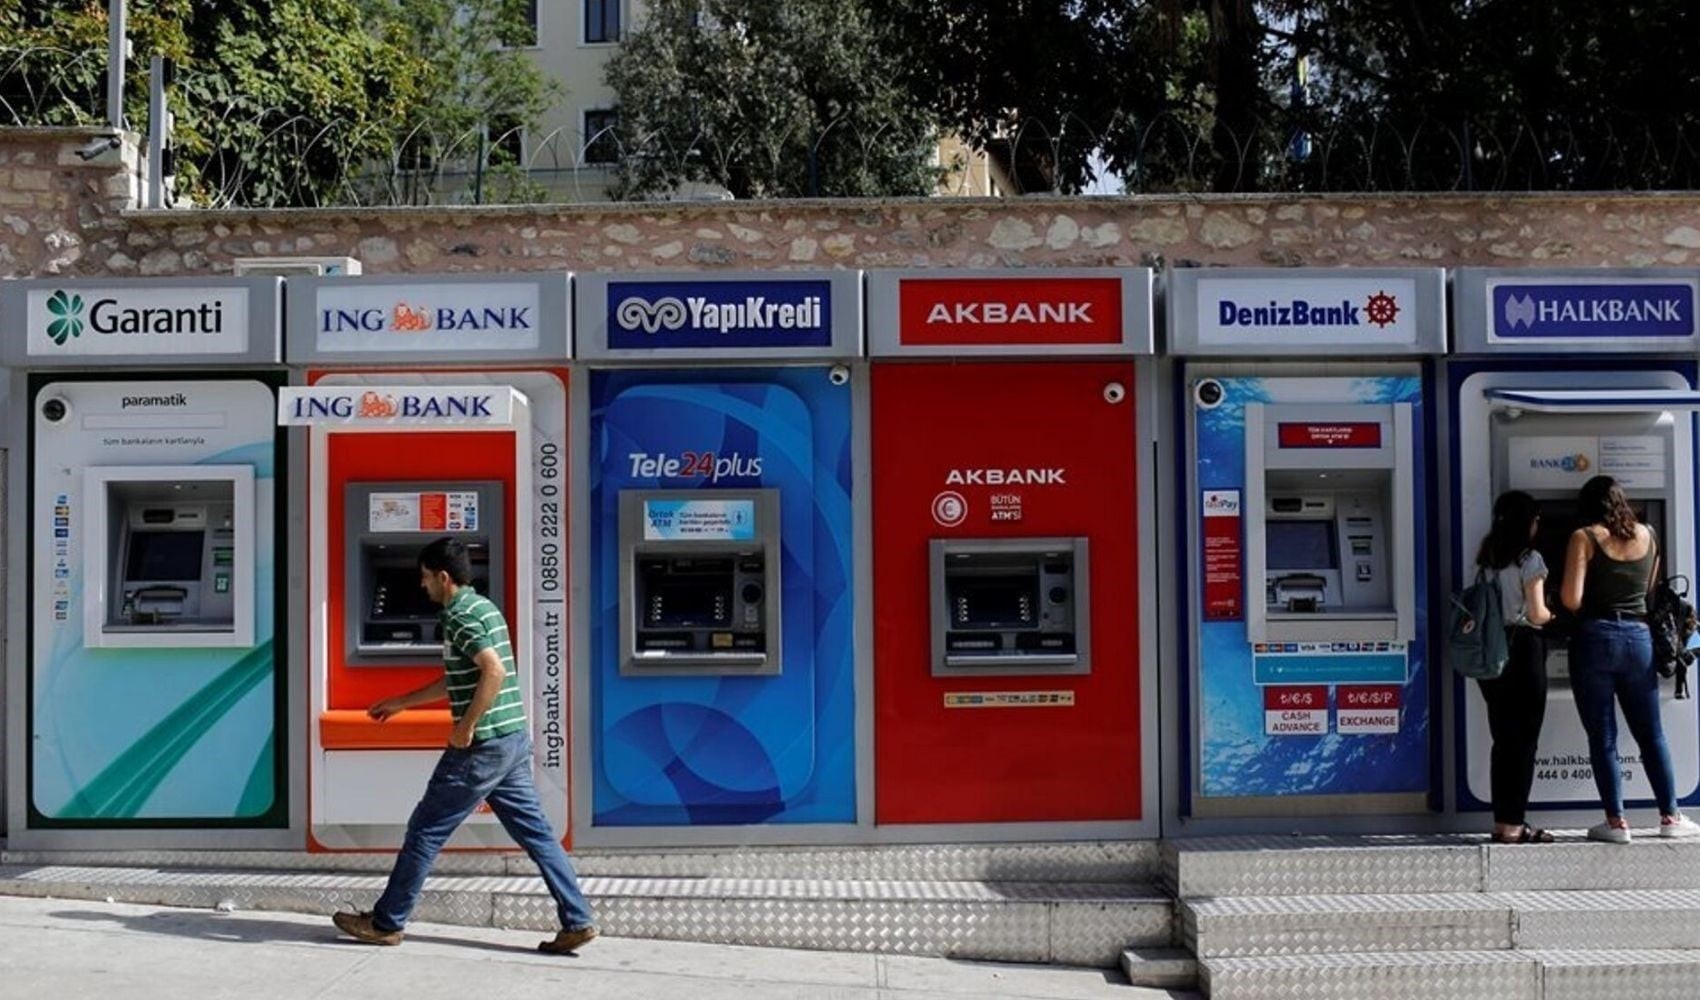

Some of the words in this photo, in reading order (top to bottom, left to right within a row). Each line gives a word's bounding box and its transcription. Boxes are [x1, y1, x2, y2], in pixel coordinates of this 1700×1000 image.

[90, 299, 222, 334] Garanti
[321, 309, 385, 331] ING
[436, 307, 530, 330] BANK
[687, 297, 821, 333] YapıKredi
[926, 302, 1094, 323] AKBANK
[1219, 300, 1360, 326] DenizBank
[1539, 299, 1681, 322] HALKBANK
[122, 393, 187, 408] paramatik
[294, 397, 353, 418] ING
[403, 395, 492, 417] BANK
[541, 443, 558, 479] 600
[628, 451, 763, 483] Tele24plus
[945, 469, 1066, 485] AKBANK
[541, 485, 558, 496] 0
[541, 503, 558, 537] 222
[541, 543, 559, 591] 0850
[543, 612, 564, 768] ingbank.com.tr
[1272, 722, 1320, 732] ADVANCE
[1281, 712, 1311, 721] CASH
[1340, 716, 1396, 726] EXCHANGE
[1537, 769, 1558, 780] 444
[1561, 769, 1569, 780] 0
[1571, 769, 1592, 780] 400
